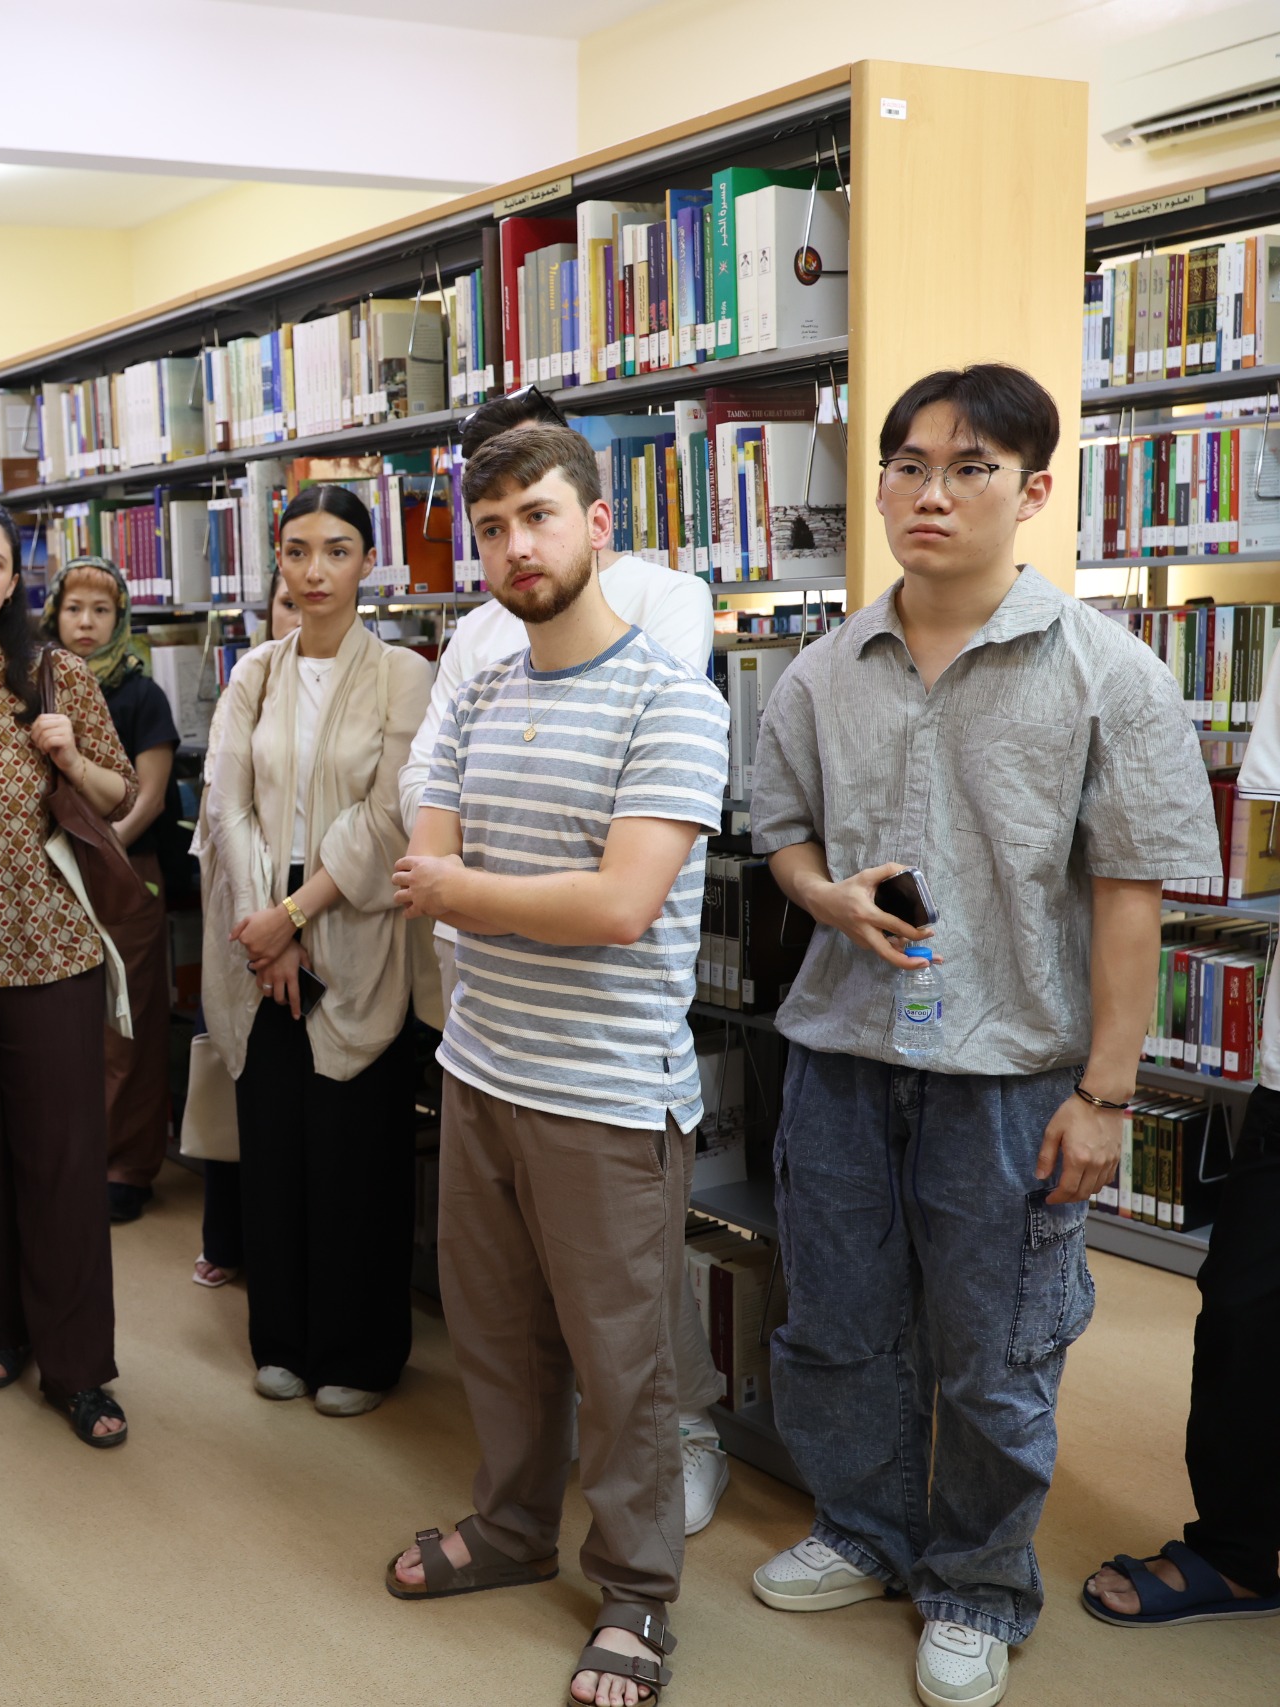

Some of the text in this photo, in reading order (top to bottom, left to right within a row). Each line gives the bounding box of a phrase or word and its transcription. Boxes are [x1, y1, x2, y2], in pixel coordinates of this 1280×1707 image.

[504, 184, 561, 210] المجموعة العمانية
[1164, 194, 1194, 209] العلوم
[717, 182, 728, 247] مسيرة الخير
[726, 409, 805, 418] TAMING THE GREAT DESERT
